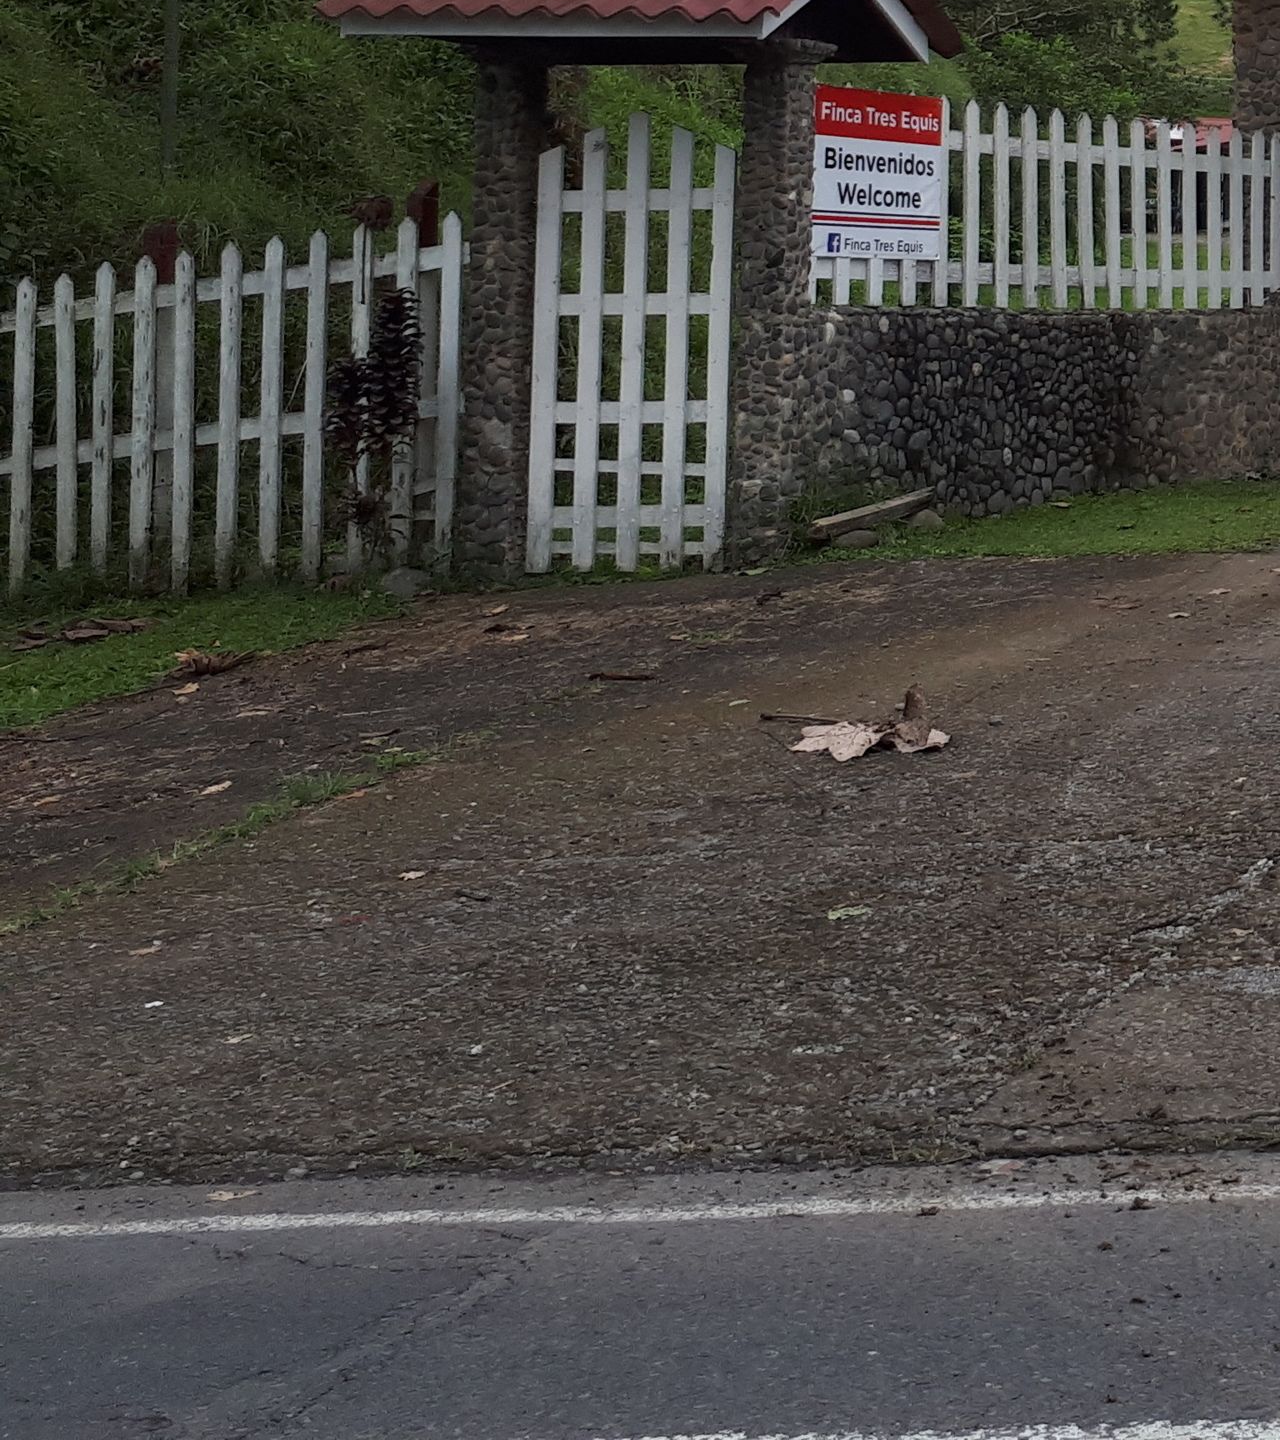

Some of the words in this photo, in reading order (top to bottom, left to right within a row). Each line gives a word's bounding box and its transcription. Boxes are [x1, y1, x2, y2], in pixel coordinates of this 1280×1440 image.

[821, 101, 862, 124] Finca
[866, 107, 897, 127] Tres
[901, 111, 940, 133] Equis
[824, 147, 935, 177] Bienvenidos
[837, 182, 922, 209] Welcome
[844, 238, 871, 251] Finca
[874, 239, 894, 252] Tres
[897, 240, 924, 254] Equis
